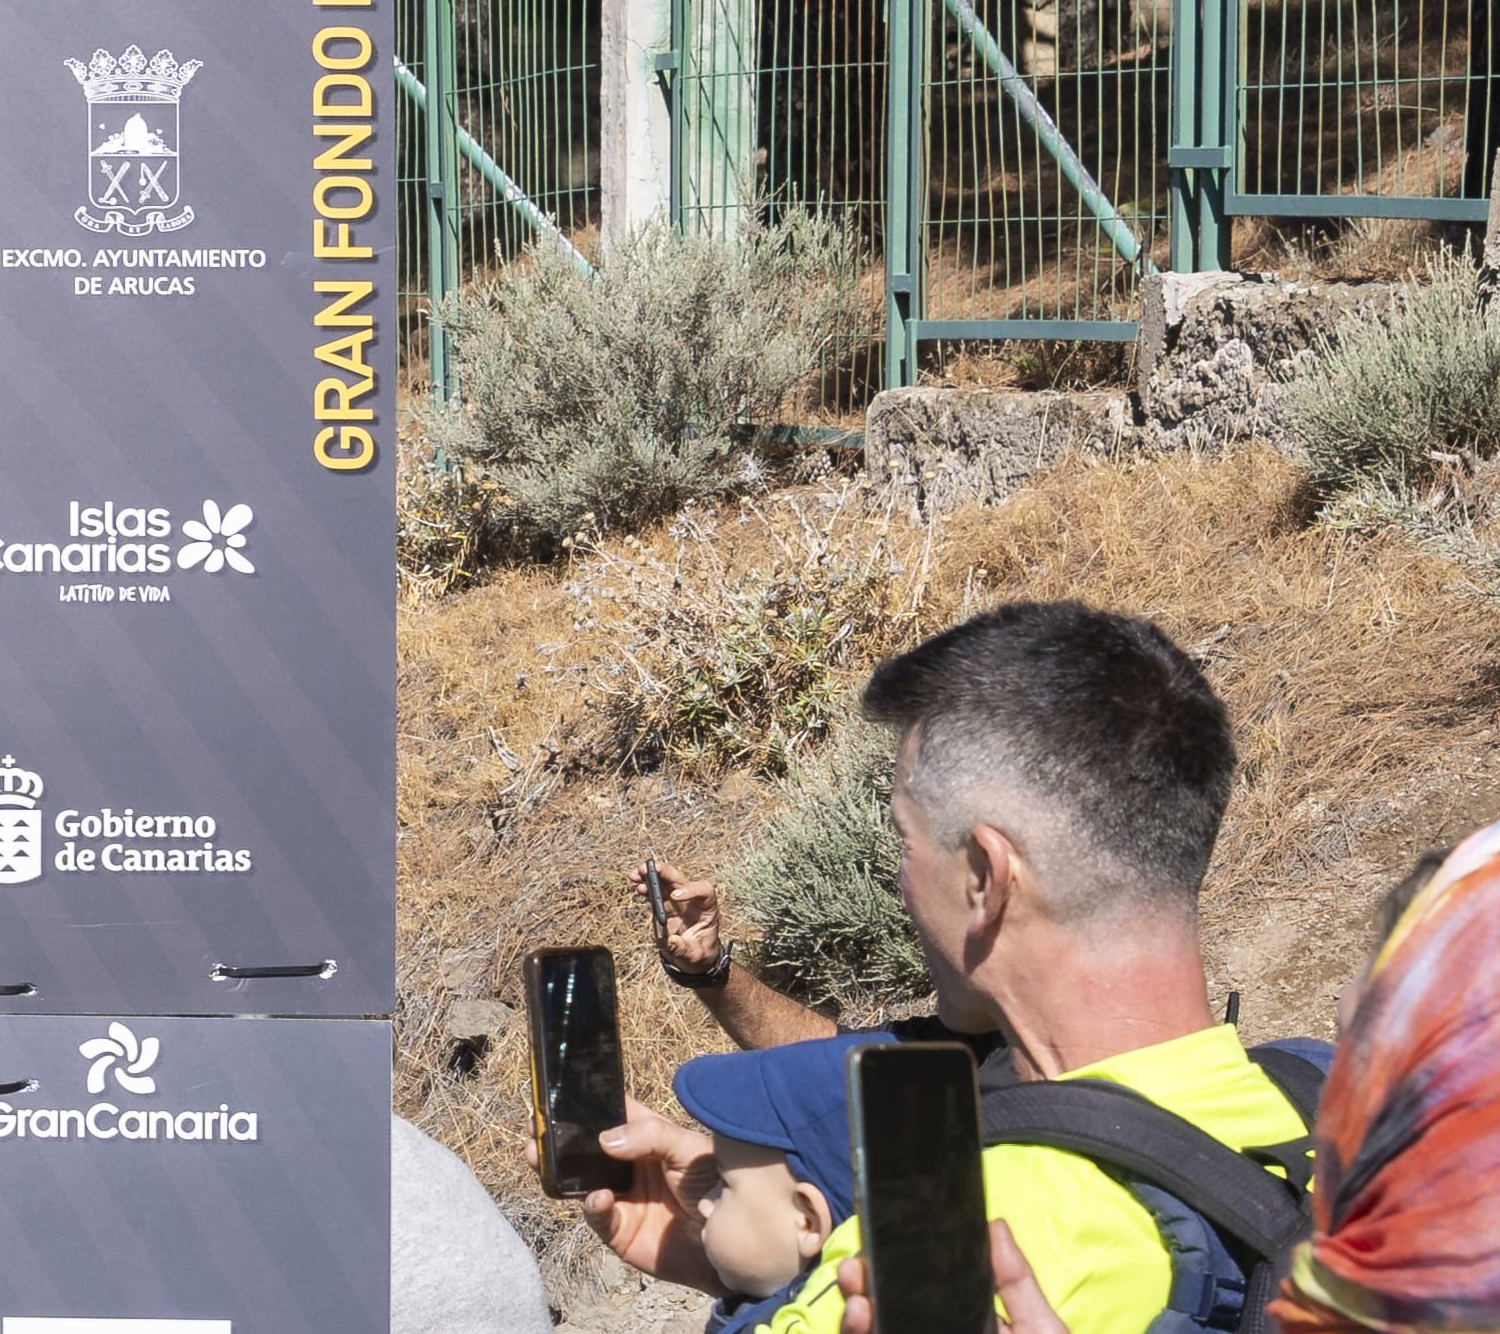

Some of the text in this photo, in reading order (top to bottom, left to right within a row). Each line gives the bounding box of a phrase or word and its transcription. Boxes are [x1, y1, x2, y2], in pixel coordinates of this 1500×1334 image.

[312, 25, 374, 258] FONDO
[2, 248, 267, 269] EXCMO. AYUNTAMIENTO
[74, 276, 195, 296] DE ARUCAS
[313, 279, 375, 471] GRAN
[69, 500, 171, 538] Islas
[59, 583, 171, 604] LATITUD DE VIDA
[54, 809, 217, 840] Gobierno
[54, 844, 252, 873] de Canarias
